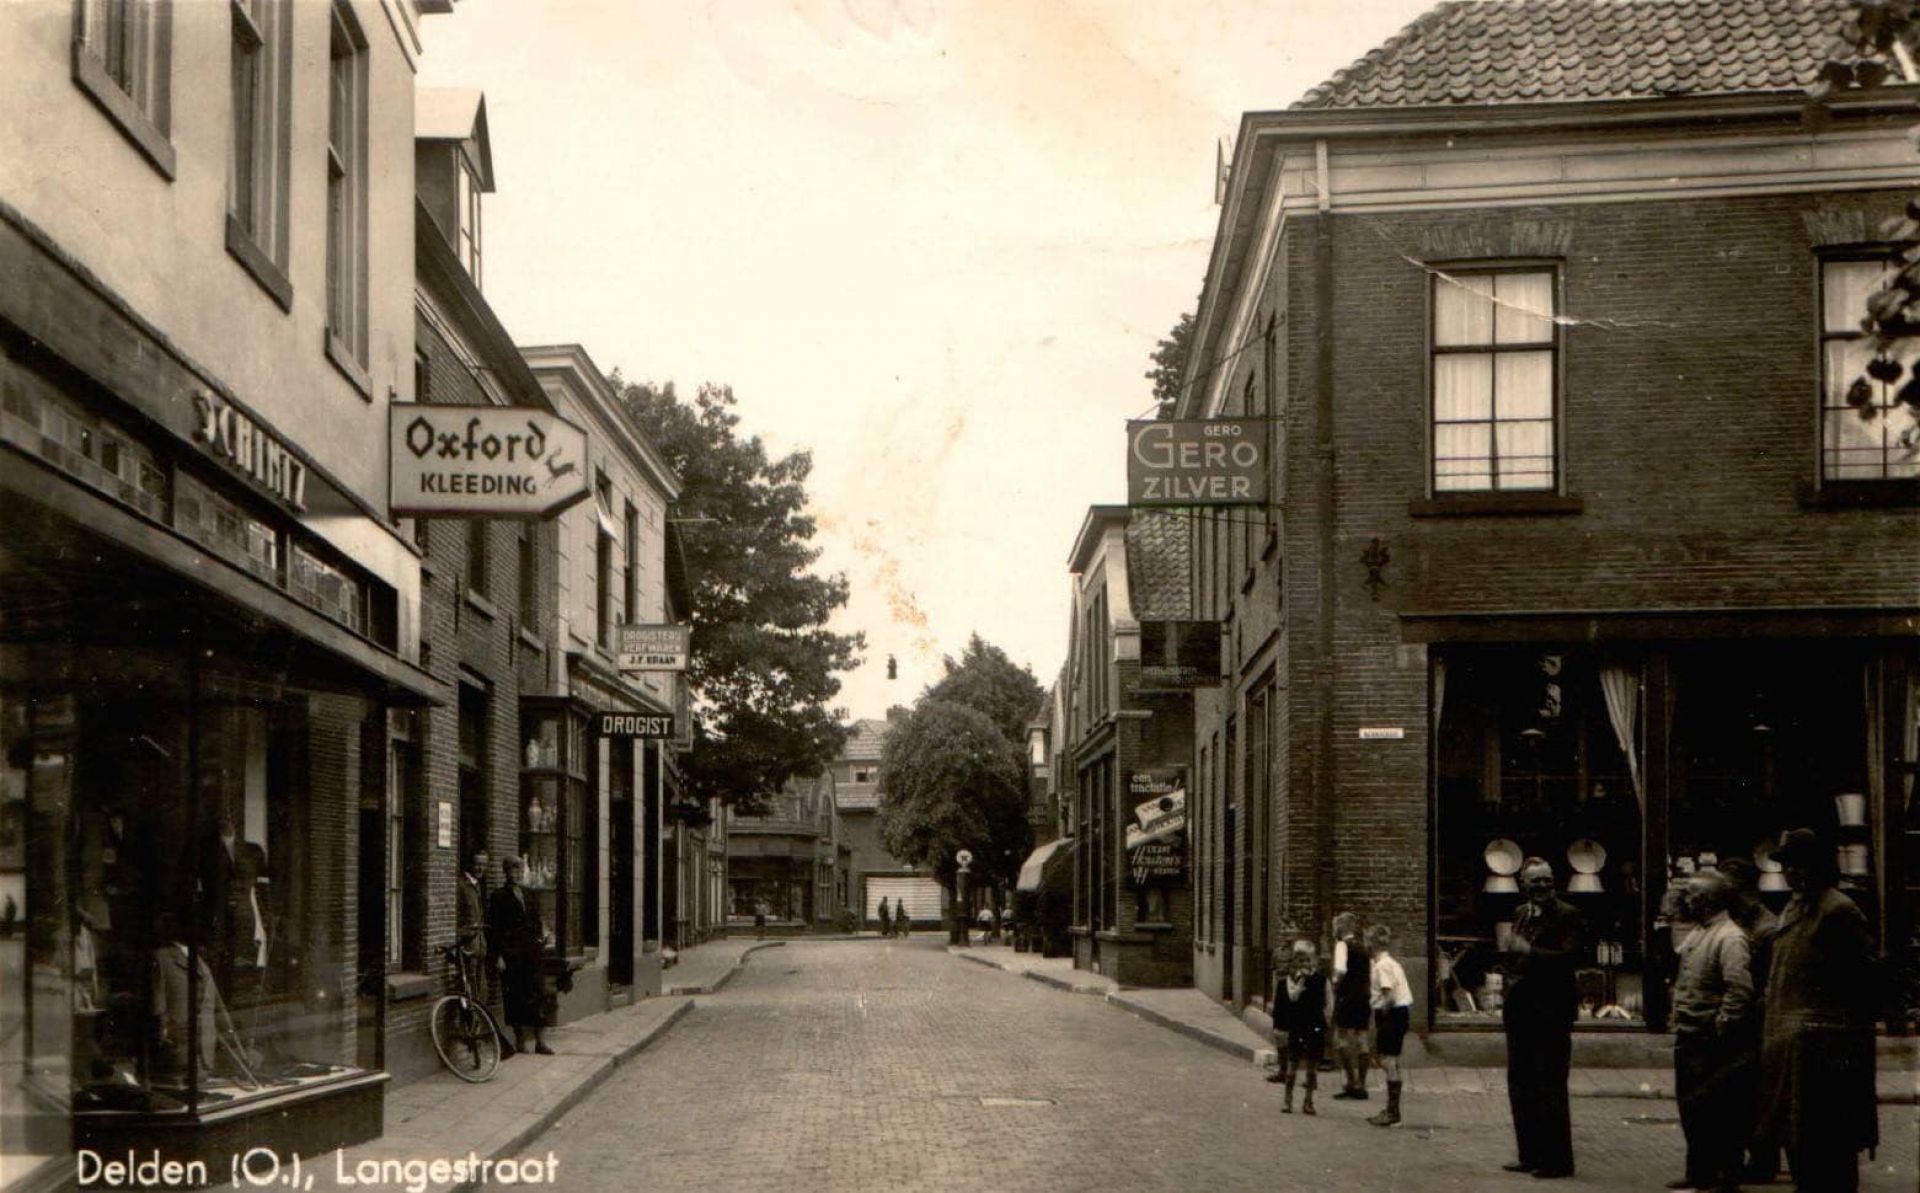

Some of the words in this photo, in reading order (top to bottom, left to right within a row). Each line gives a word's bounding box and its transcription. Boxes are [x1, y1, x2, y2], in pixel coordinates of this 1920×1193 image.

[406, 415, 546, 461] Oxford
[1203, 424, 1242, 437] GERO
[420, 472, 537, 495] KLEEDING
[1141, 475, 1251, 499] ZILVER
[602, 716, 672, 735] DROGIST
